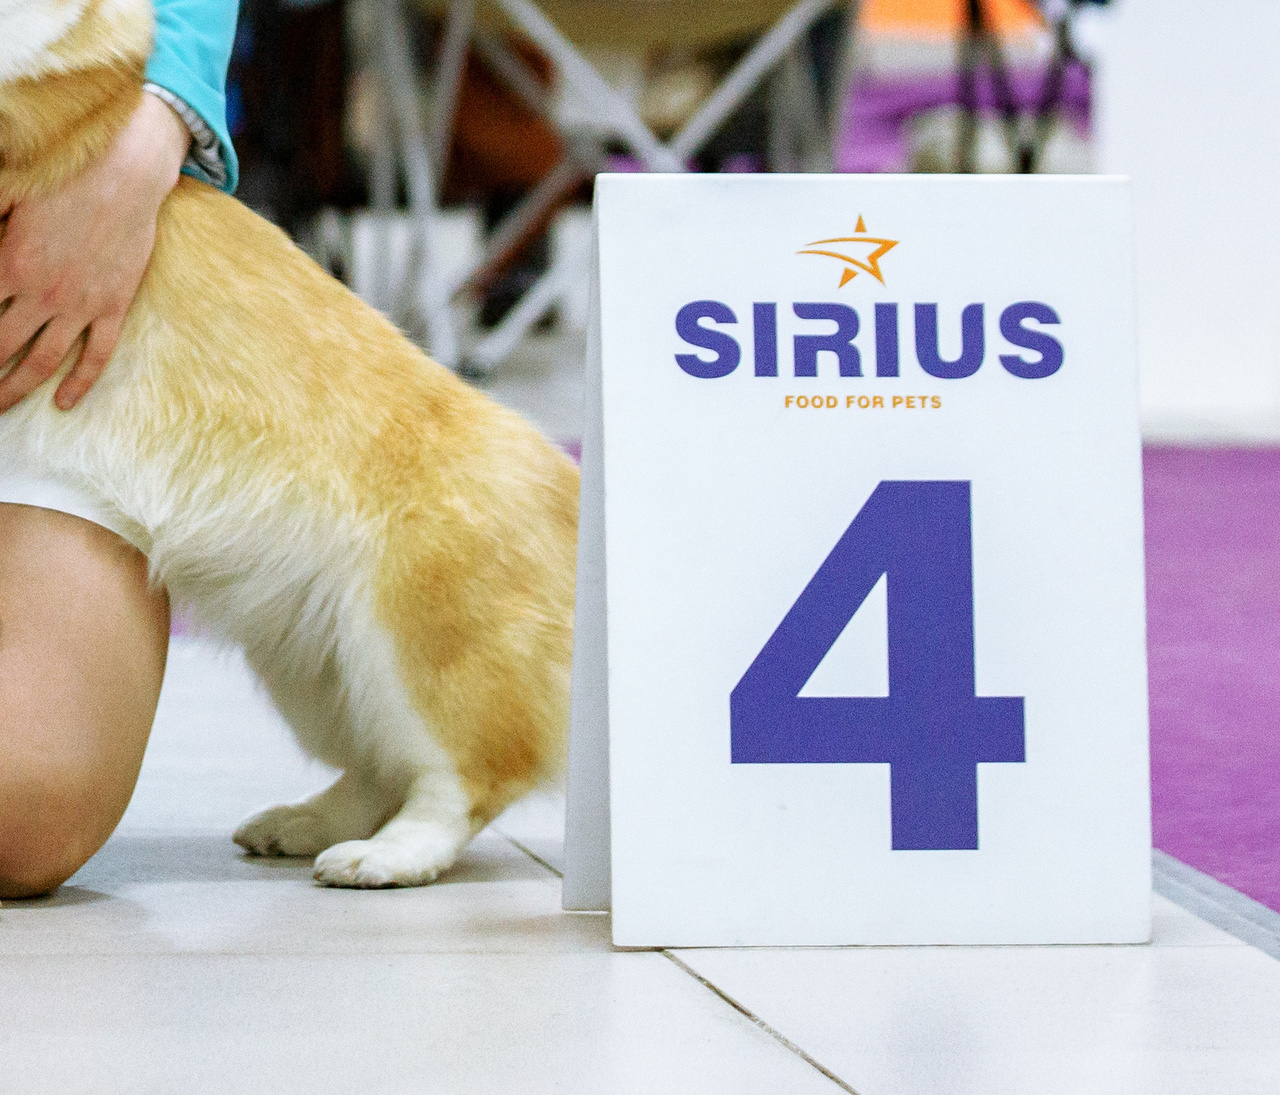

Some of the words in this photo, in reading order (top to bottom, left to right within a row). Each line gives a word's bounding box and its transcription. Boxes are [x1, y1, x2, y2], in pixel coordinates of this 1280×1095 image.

[674, 299, 1065, 380] SIRIUS
[785, 394, 838, 409] FOOD
[846, 394, 884, 409] FOR
[892, 394, 942, 409] PETS
[729, 479, 1026, 850] 4
